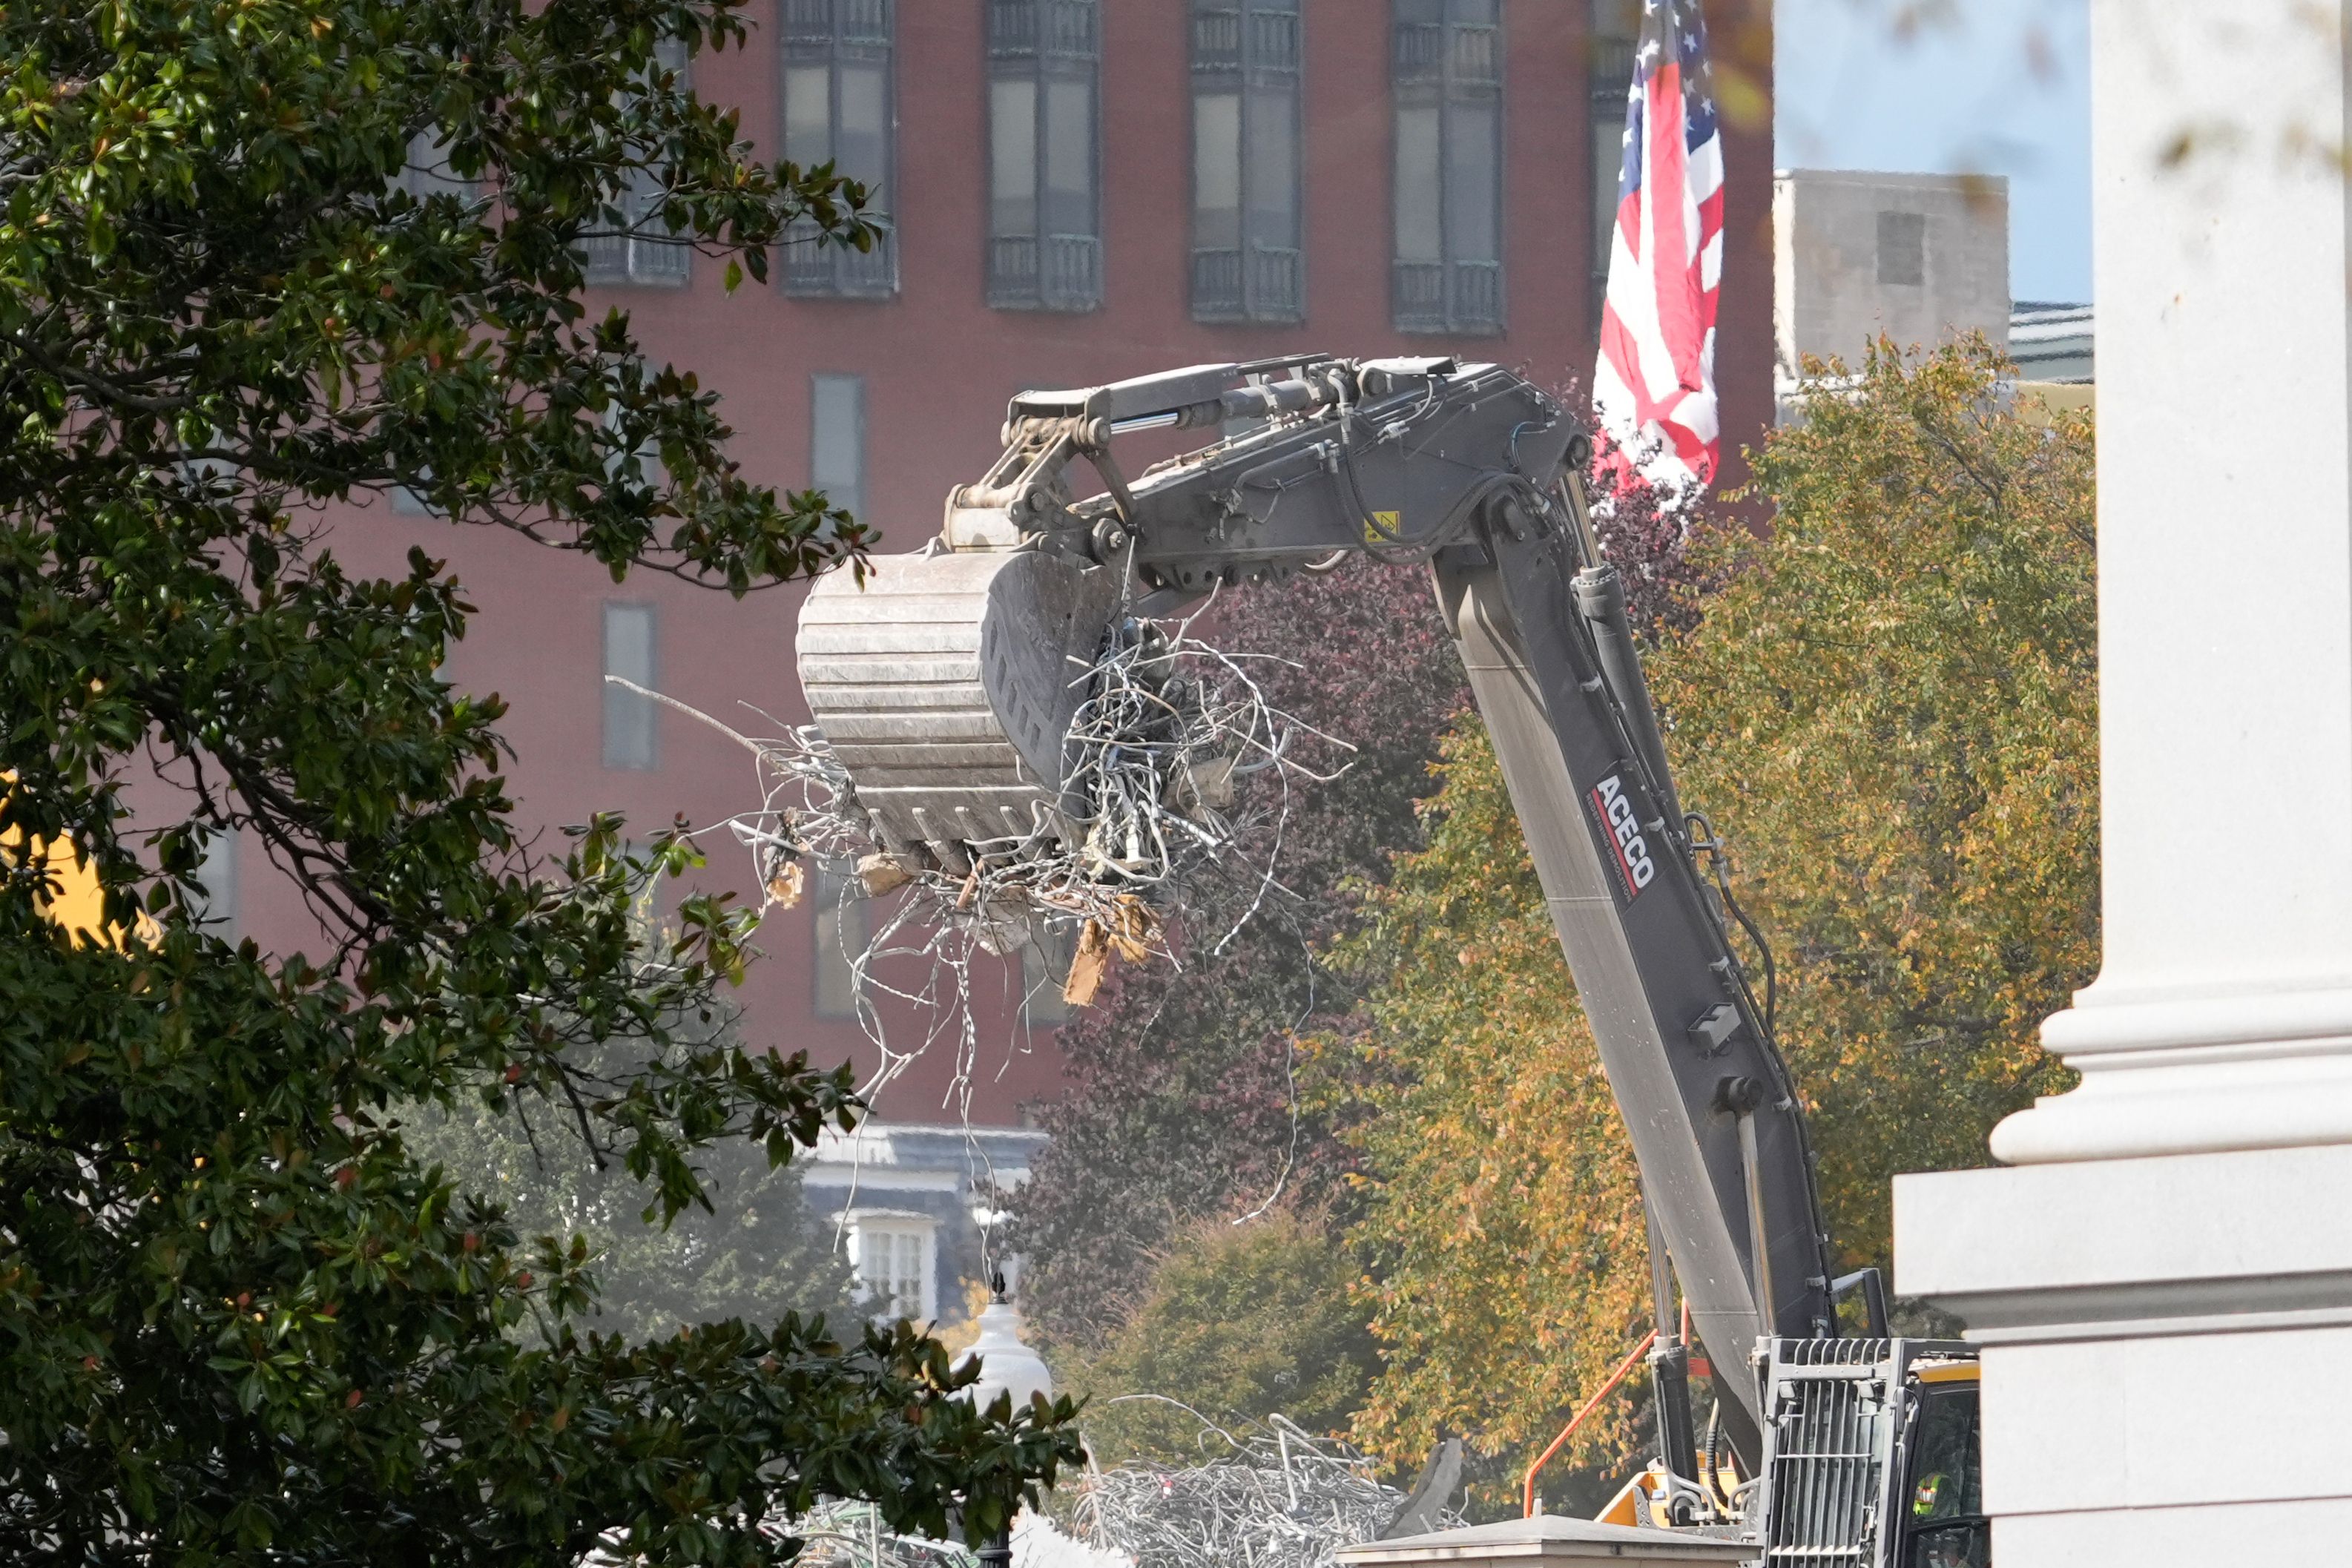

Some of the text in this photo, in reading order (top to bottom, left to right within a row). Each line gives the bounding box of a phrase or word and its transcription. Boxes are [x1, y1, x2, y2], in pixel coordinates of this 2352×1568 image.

[1586, 793, 1632, 903] REDEFINING DEMOLITION
[1597, 775, 1654, 889] ACECO
